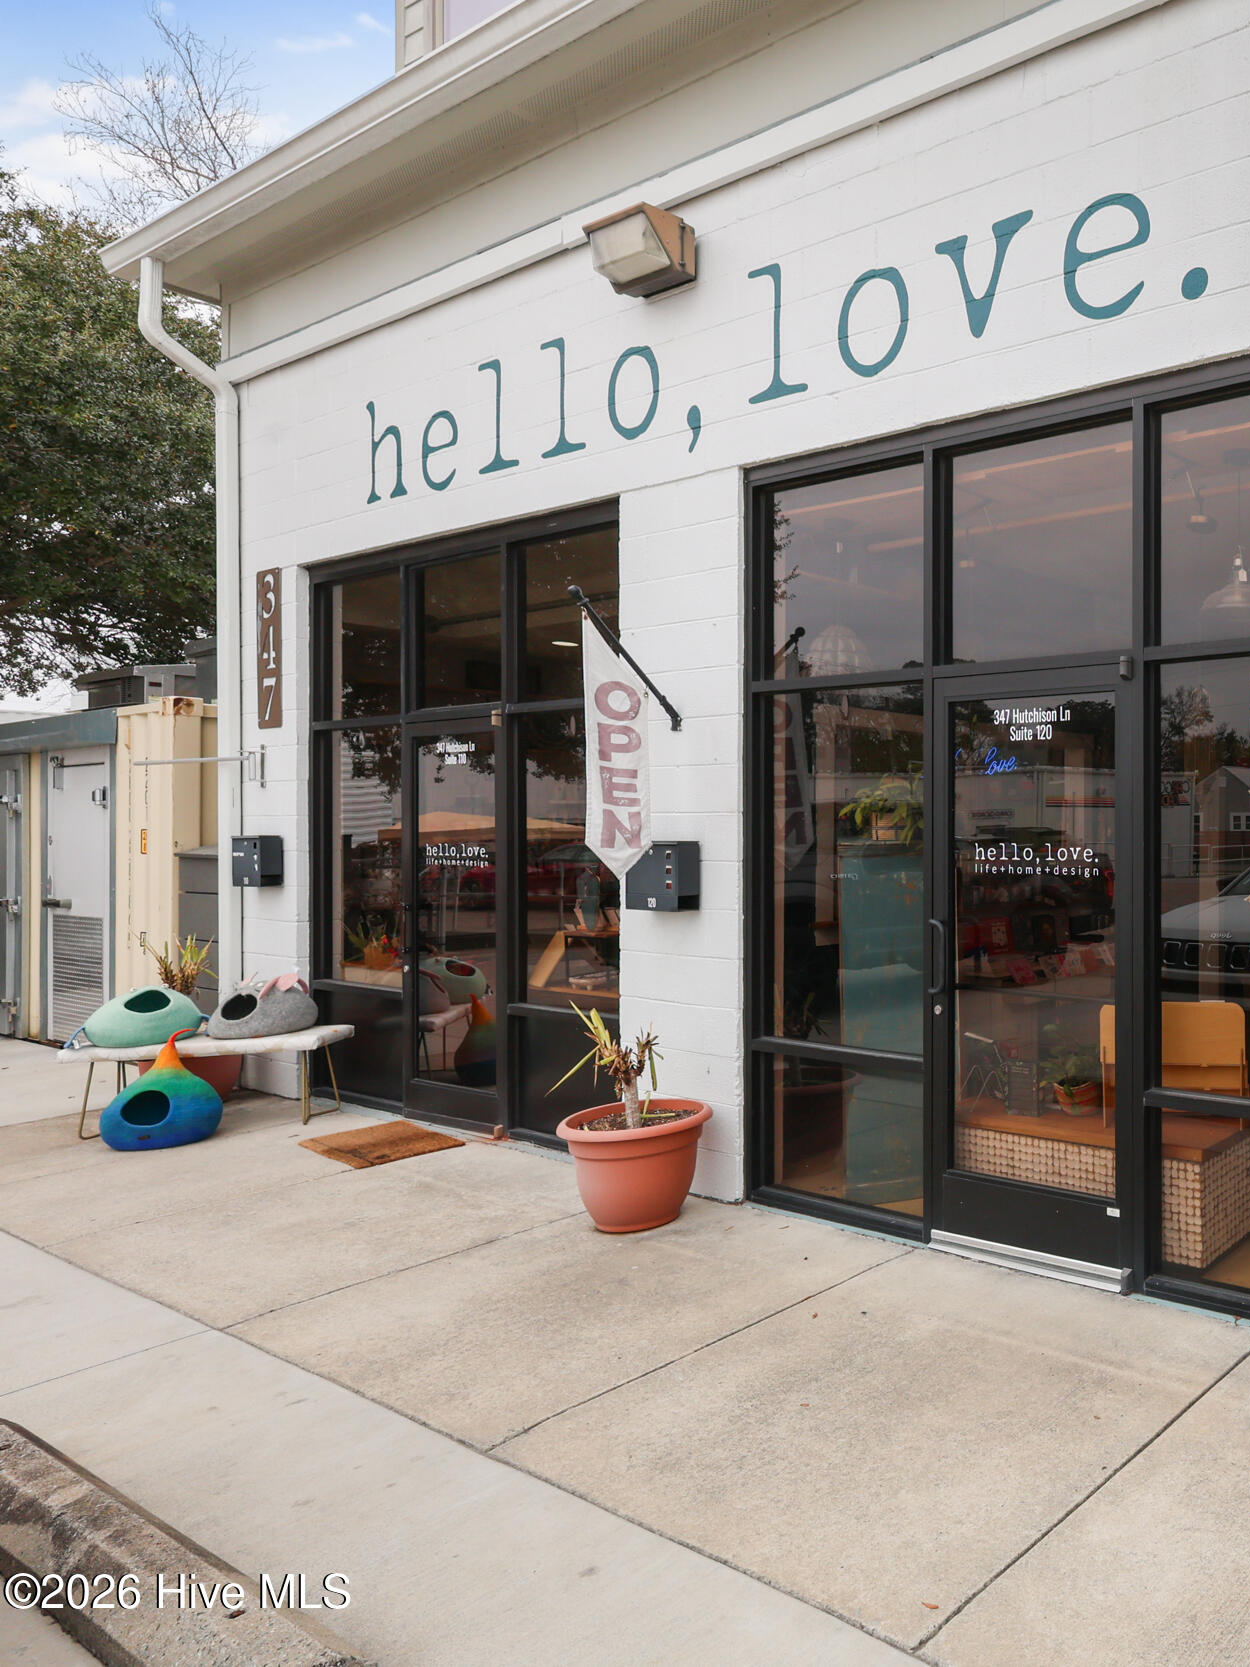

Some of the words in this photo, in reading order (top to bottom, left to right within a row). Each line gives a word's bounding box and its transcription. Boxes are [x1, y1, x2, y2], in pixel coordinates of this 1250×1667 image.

[748, 192, 1209, 404] love.
[262, 573, 277, 721] 347
[993, 709, 1011, 725] 347
[1012, 707, 1057, 724] Hutchison
[1060, 706, 1071, 722] Ln
[594, 681, 643, 849] OPEN
[1009, 726, 1033, 741] Suite
[1035, 724, 1053, 740] 120
